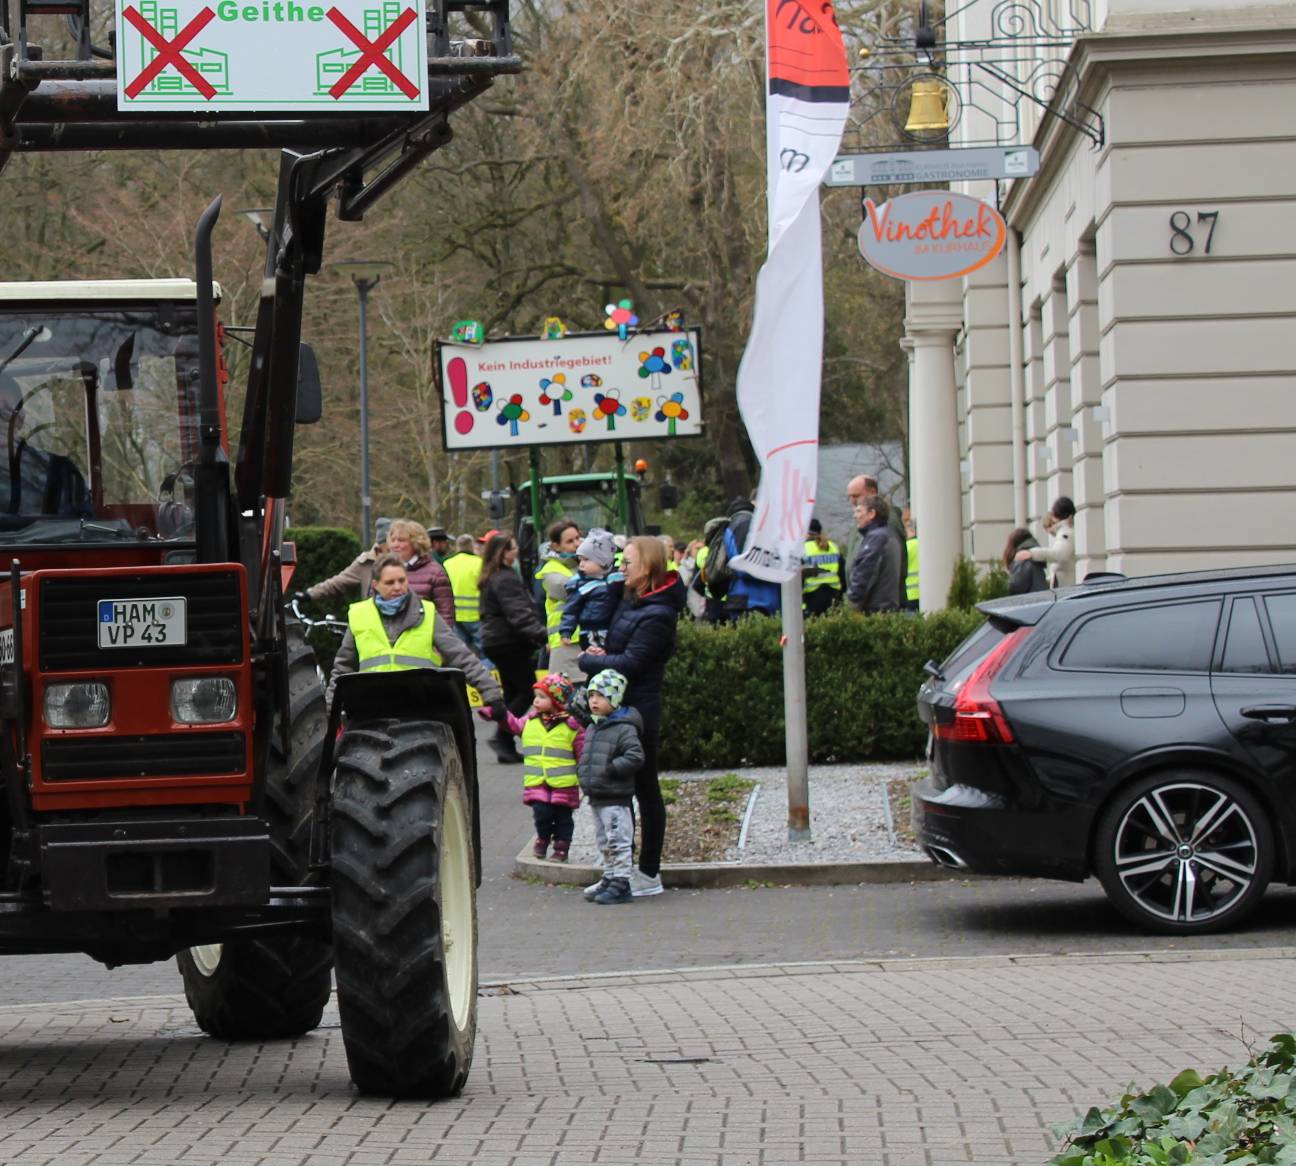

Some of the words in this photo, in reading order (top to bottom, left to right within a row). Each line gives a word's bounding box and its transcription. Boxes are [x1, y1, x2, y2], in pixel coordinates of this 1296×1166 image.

[218, 0, 325, 22] Geithe
[865, 199, 991, 240] Vinothek
[1170, 210, 1219, 255] 87
[478, 361, 506, 372] Kein
[510, 355, 611, 370] Industriegebiet!
[113, 603, 156, 624] HAM
[107, 624, 135, 645] VP
[140, 623, 167, 644] 43
